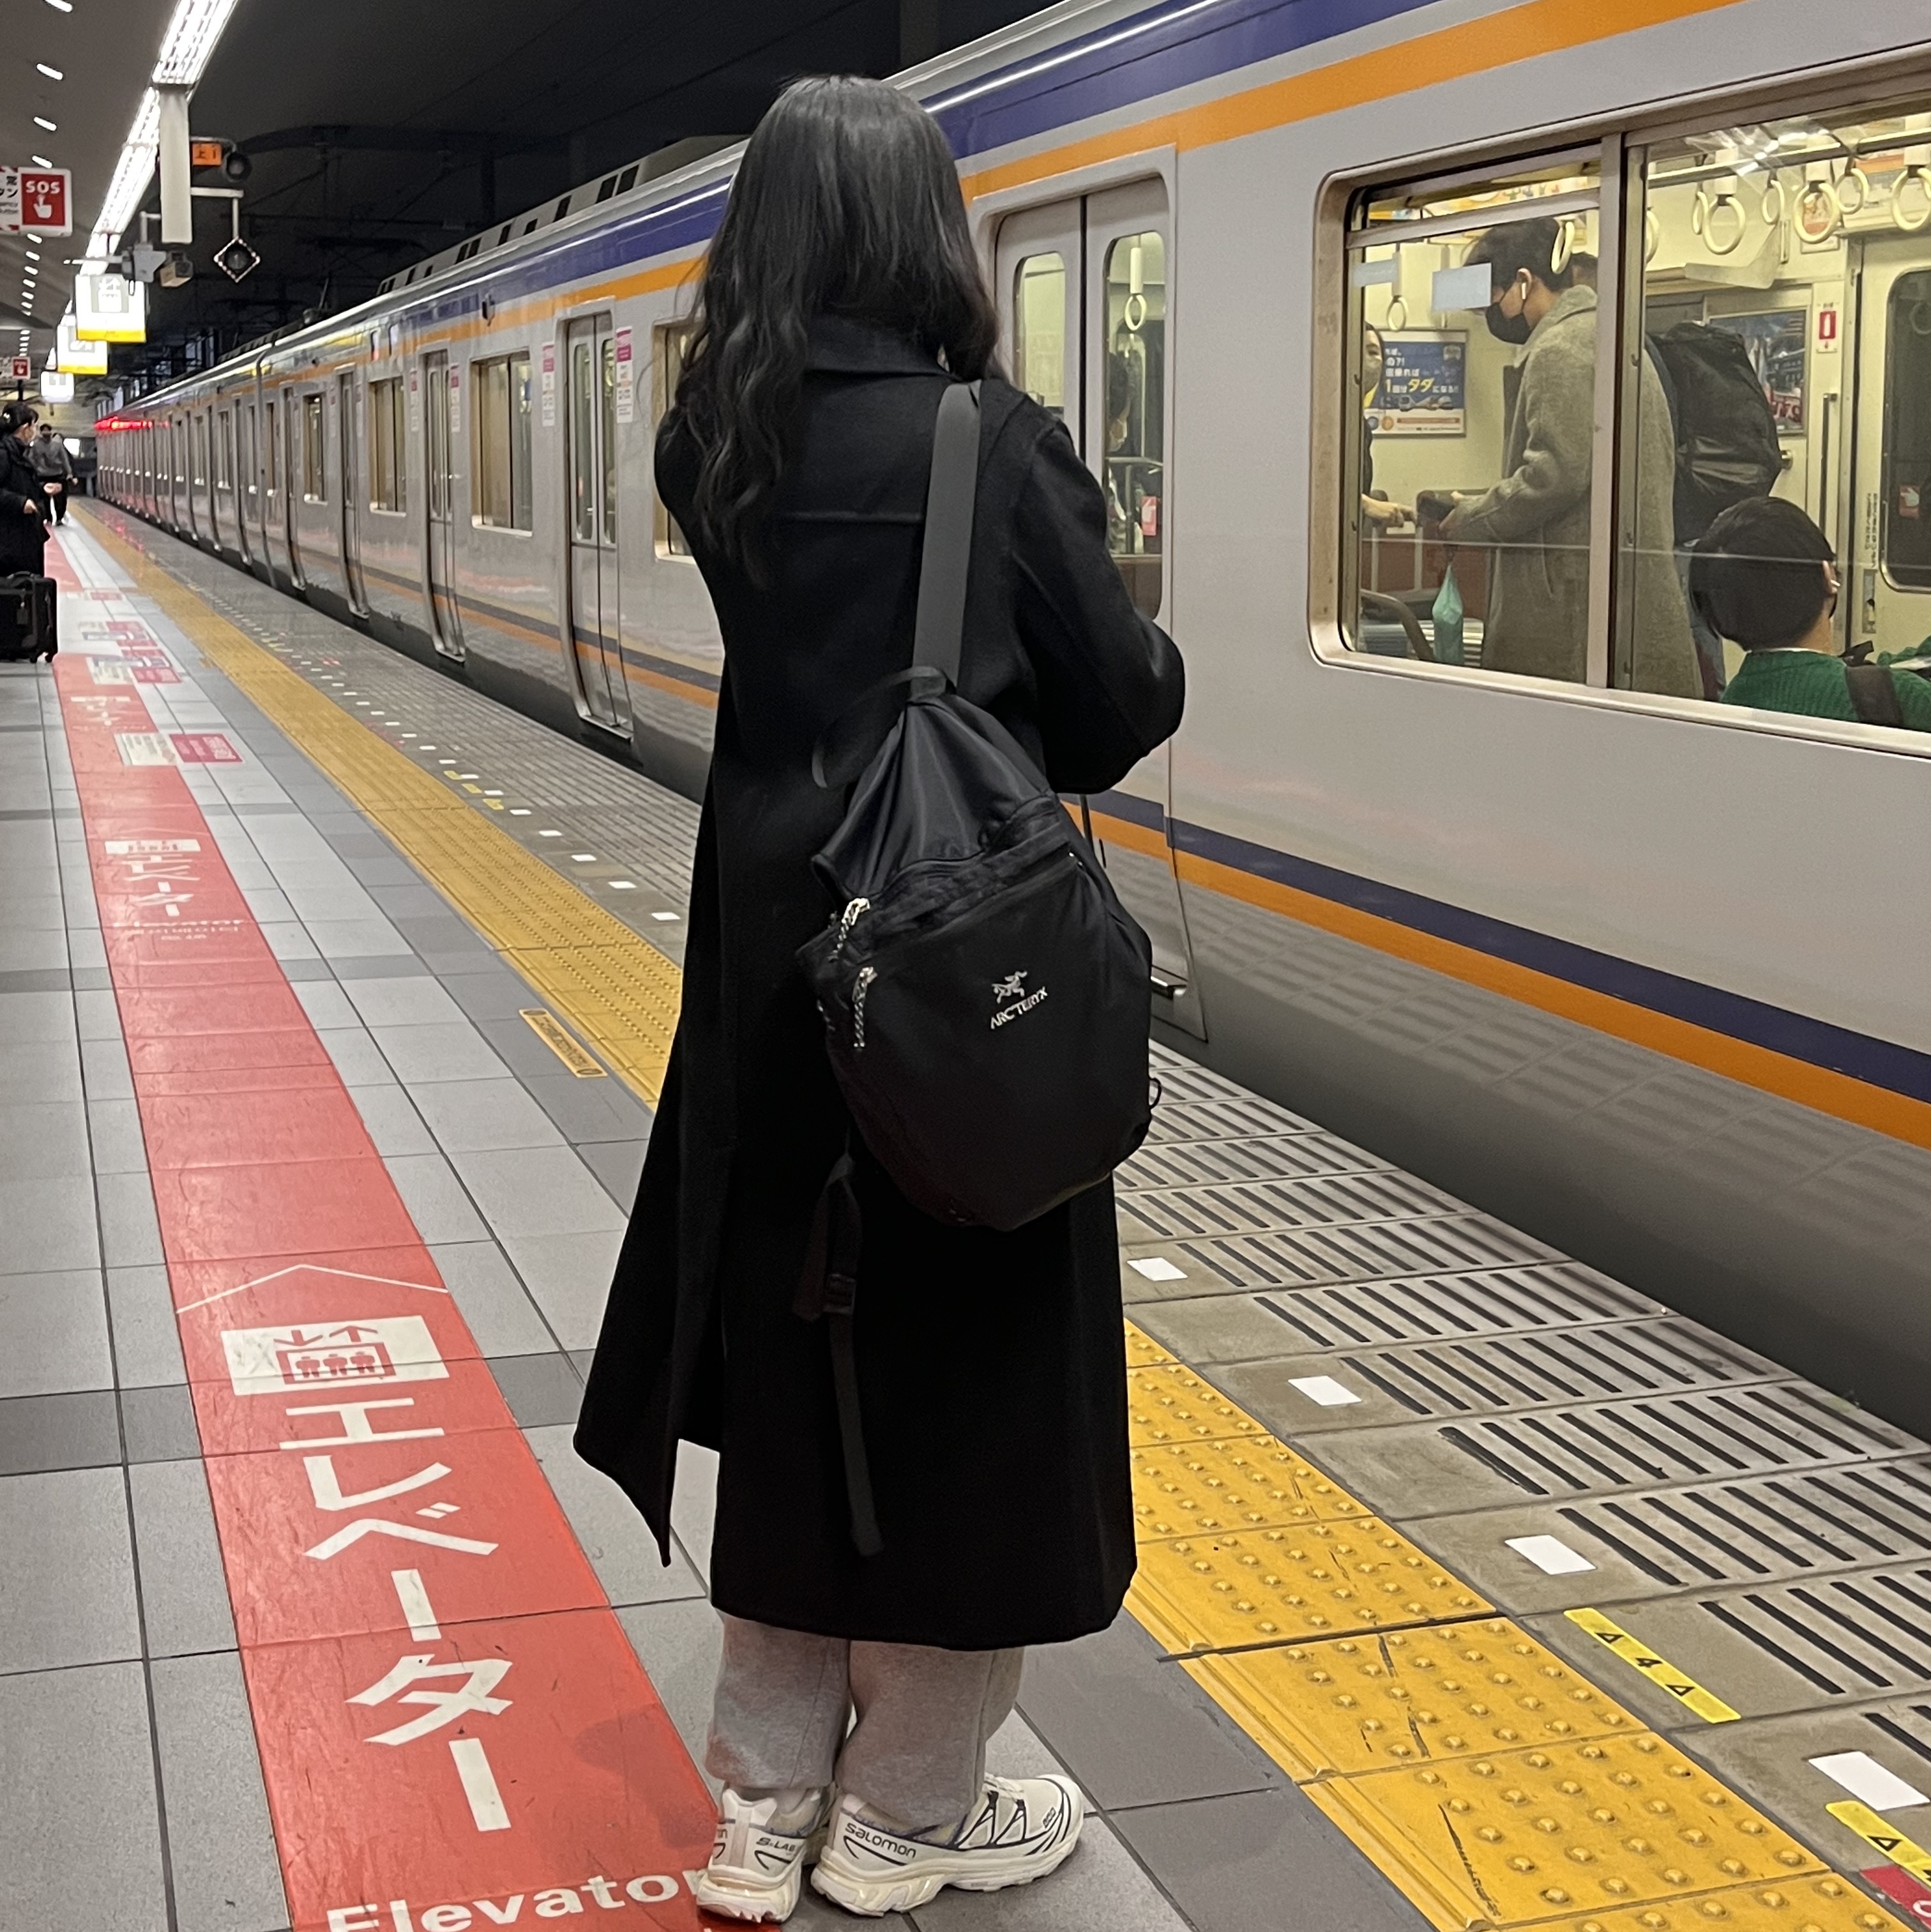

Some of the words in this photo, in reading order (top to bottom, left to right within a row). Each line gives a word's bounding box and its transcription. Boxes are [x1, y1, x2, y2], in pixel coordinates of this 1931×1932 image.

[26, 181, 61, 194] SOS
[279, 1397, 513, 1832] エレベーター
[326, 1870, 708, 1932] Elevator
